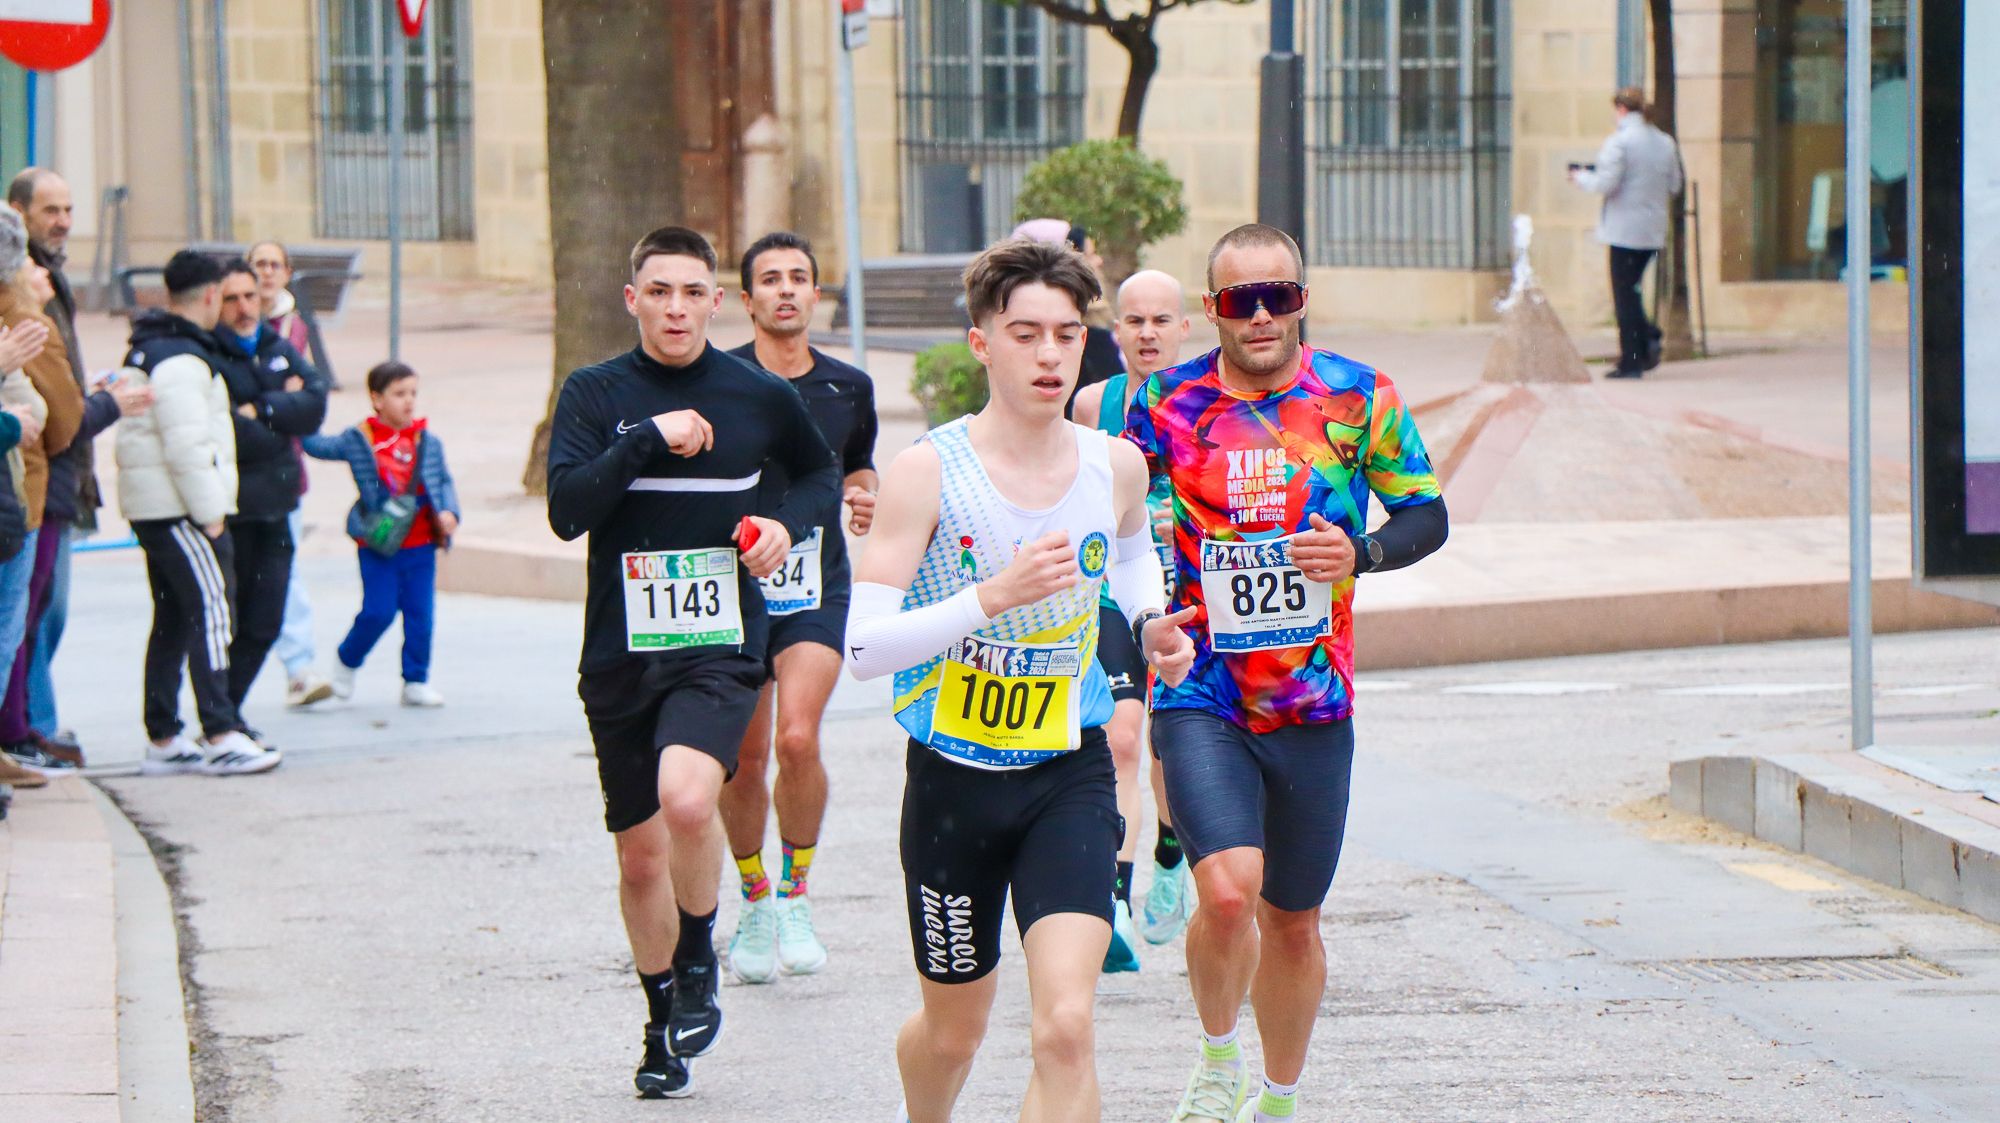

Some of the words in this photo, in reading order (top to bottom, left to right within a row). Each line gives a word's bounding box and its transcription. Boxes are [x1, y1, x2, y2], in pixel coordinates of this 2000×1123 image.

[1226, 448, 1264, 479] XII
[1265, 447, 1286, 467] 08
[1227, 478, 1266, 494] MEDIA
[1228, 489, 1287, 509] MARATÓN
[1237, 508, 1258, 523] 10K
[634, 556, 669, 578] 10K
[1218, 546, 1260, 569] 21K
[642, 580, 720, 619] 1143
[1231, 570, 1306, 616] 825
[964, 640, 1008, 677] 21K
[961, 673, 1056, 730] 1007
[921, 884, 948, 972] LUCENA
[944, 894, 977, 972] SURCO
